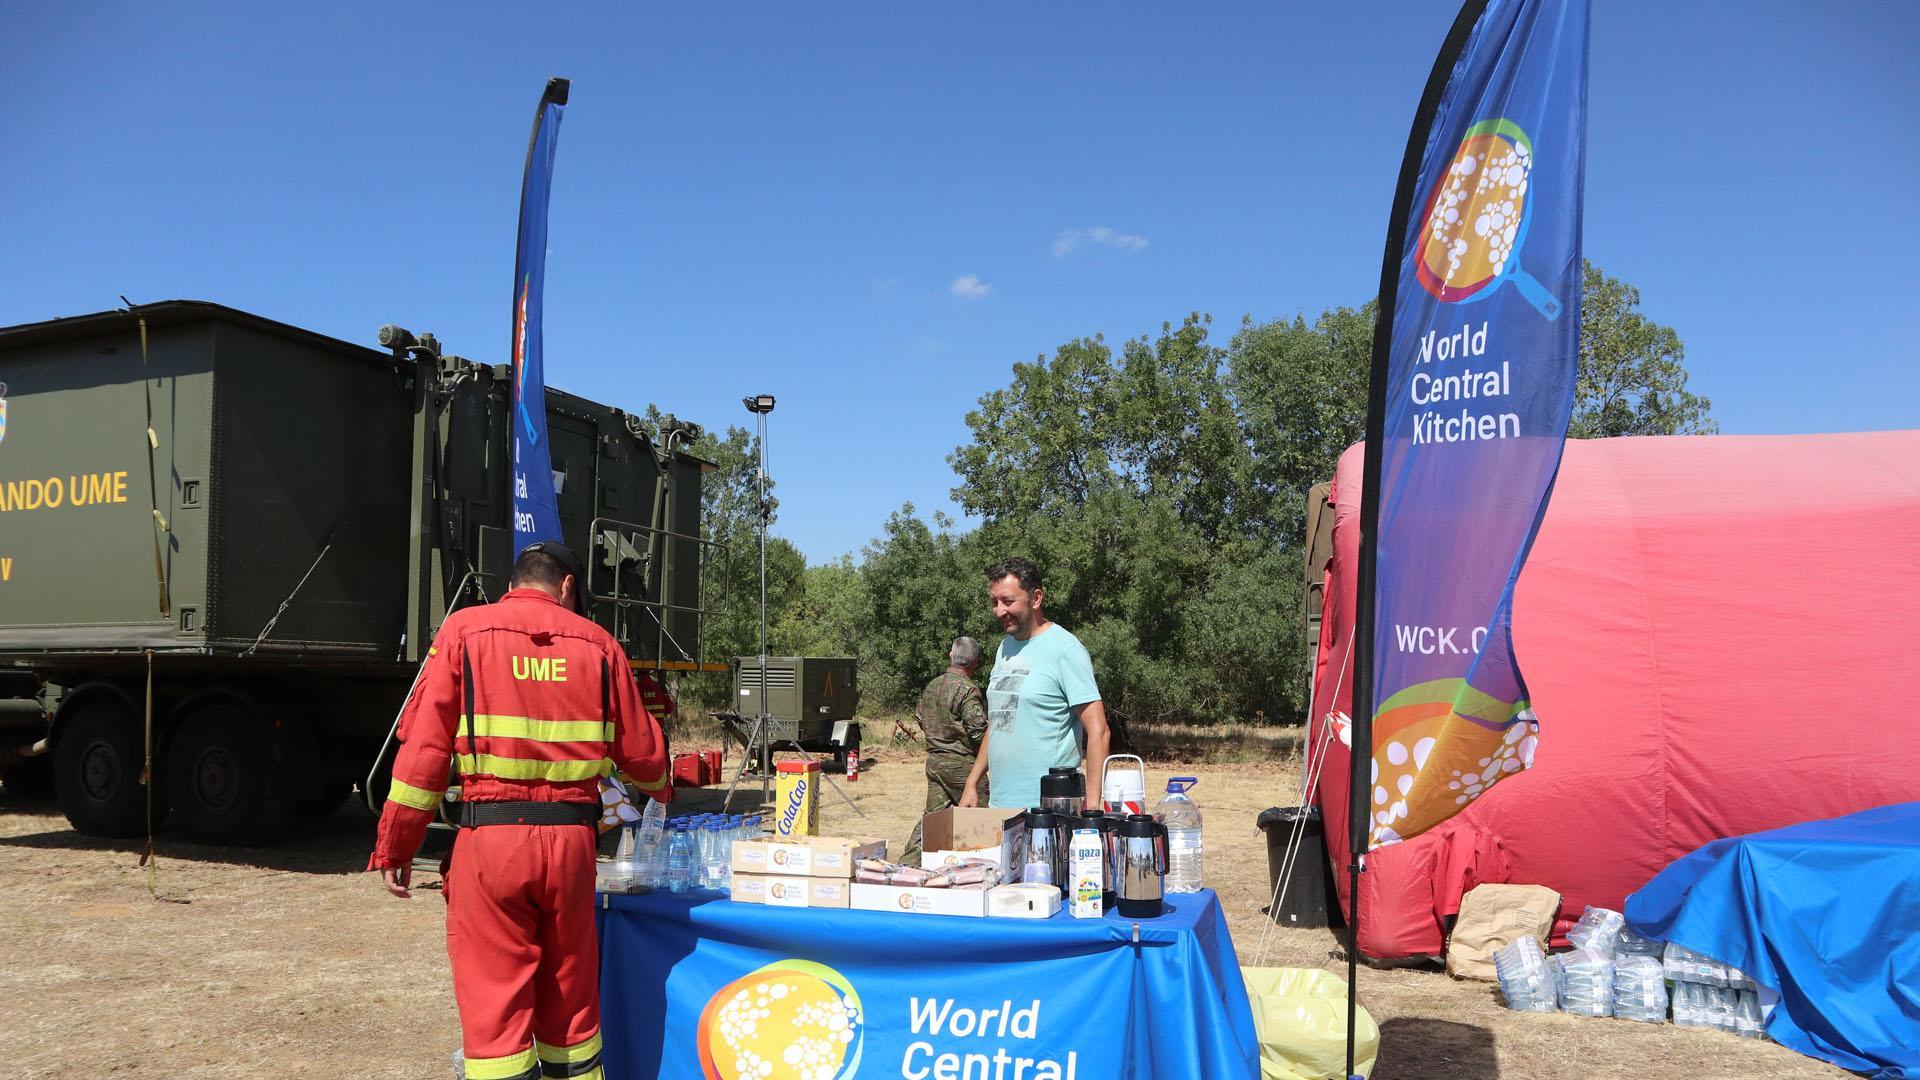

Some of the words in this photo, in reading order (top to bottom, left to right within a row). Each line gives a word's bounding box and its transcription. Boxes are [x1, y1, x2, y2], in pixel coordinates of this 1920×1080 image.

[1411, 361, 1510, 405] Central
[1413, 408, 1521, 446] Kitchen
[70, 471, 128, 506] UME
[512, 655, 568, 682] UME
[777, 779, 807, 836] ColaCao
[1078, 848, 1101, 860] gaza
[910, 997, 1041, 1040] World
[901, 1041, 1077, 1080] Central
